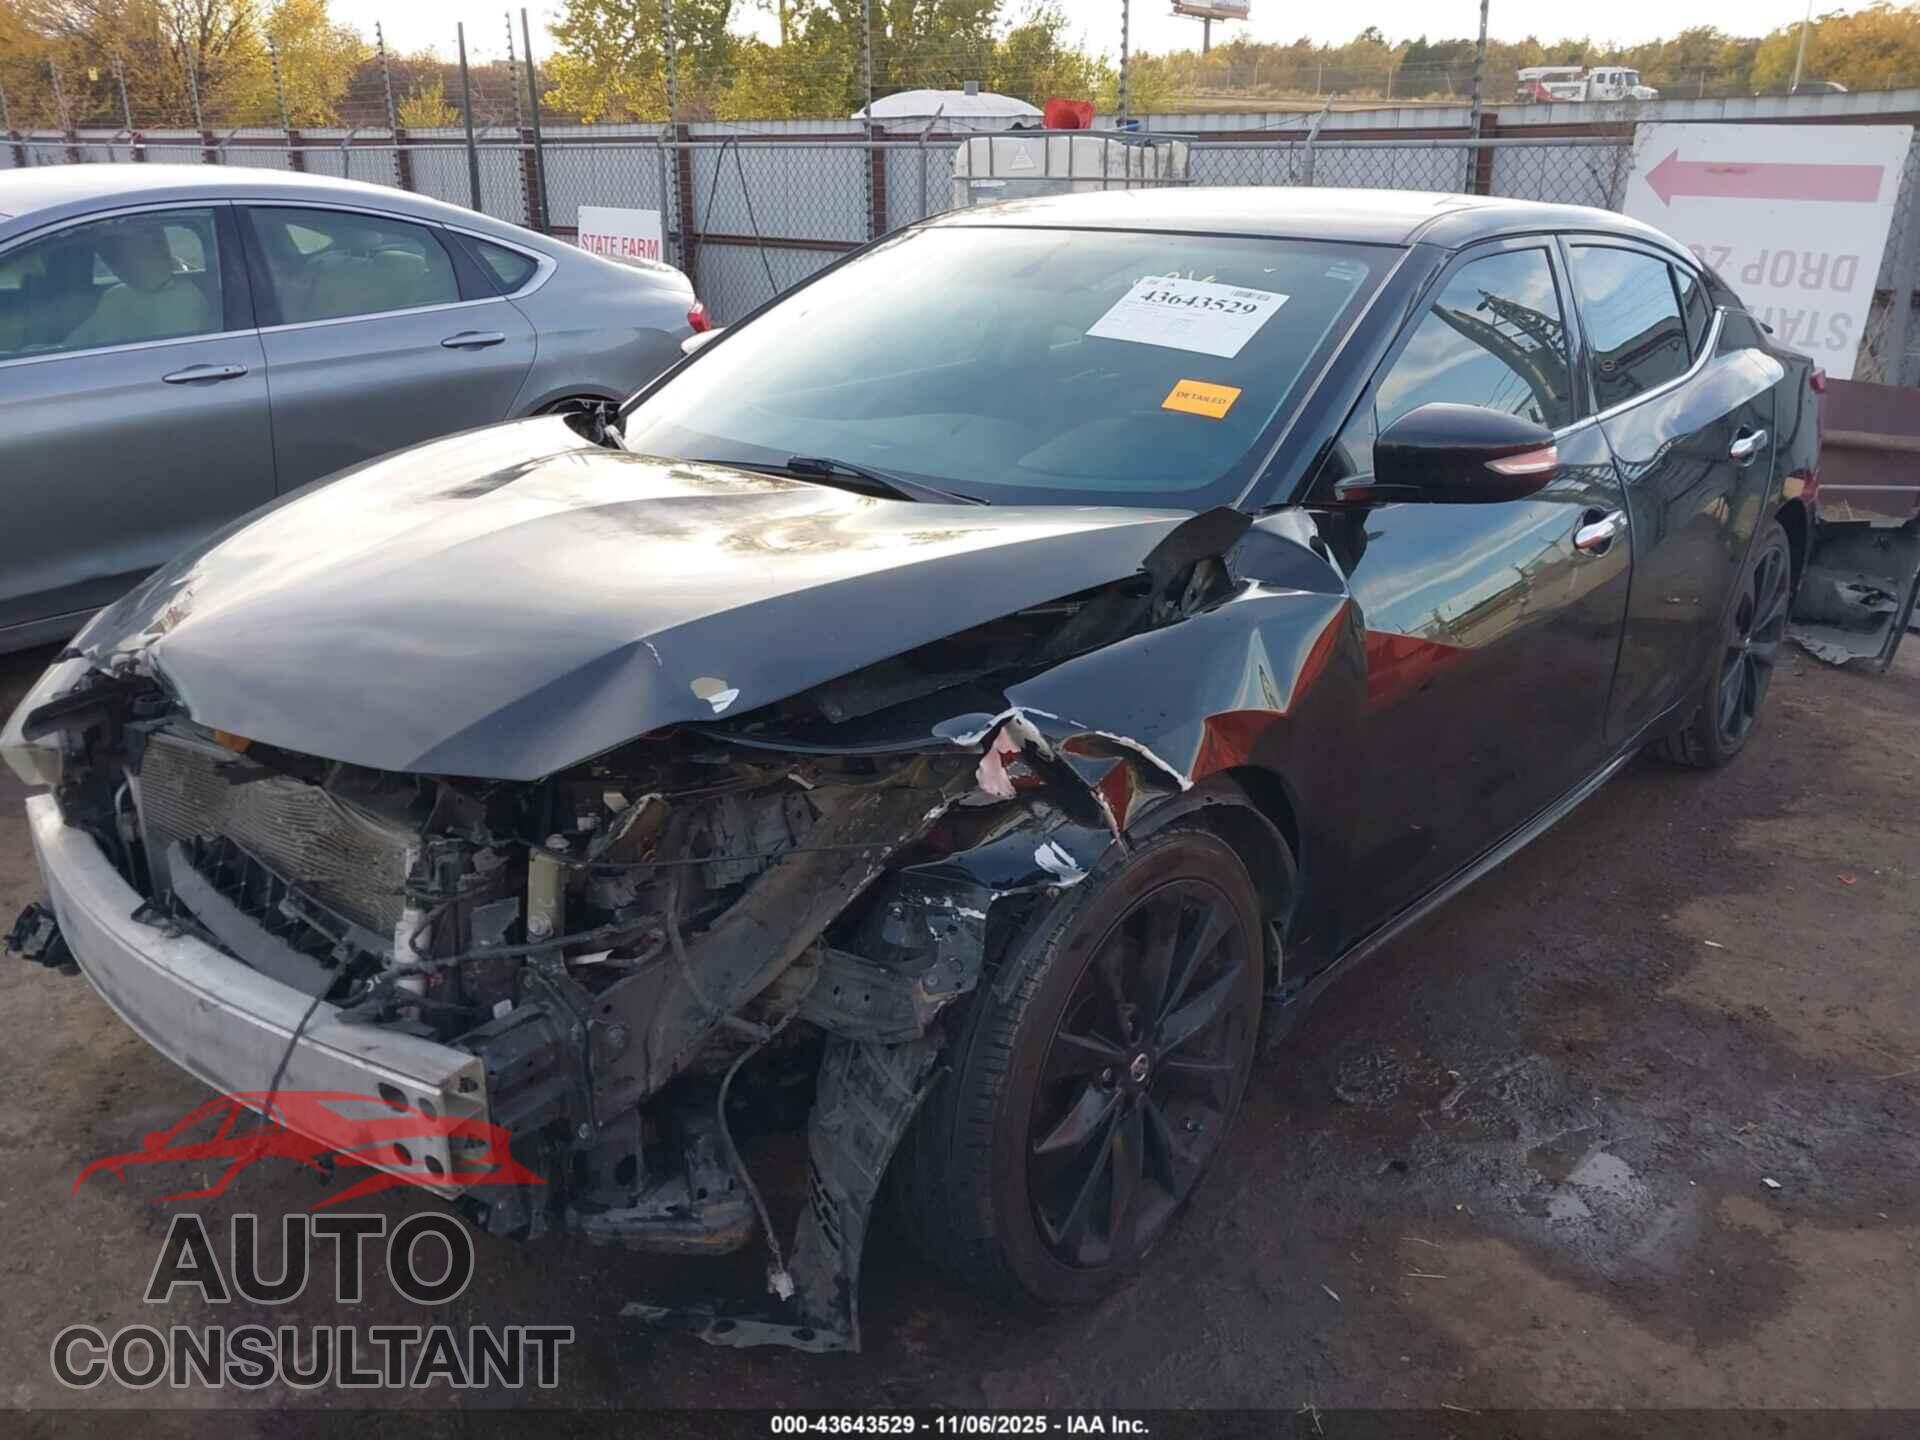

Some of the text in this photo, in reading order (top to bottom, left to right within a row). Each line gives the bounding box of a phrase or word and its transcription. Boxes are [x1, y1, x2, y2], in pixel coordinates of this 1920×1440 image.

[582, 233, 659, 261] STATE FARM
[1740, 249, 1860, 292] DROP
[1140, 290, 1258, 315] 43643529
